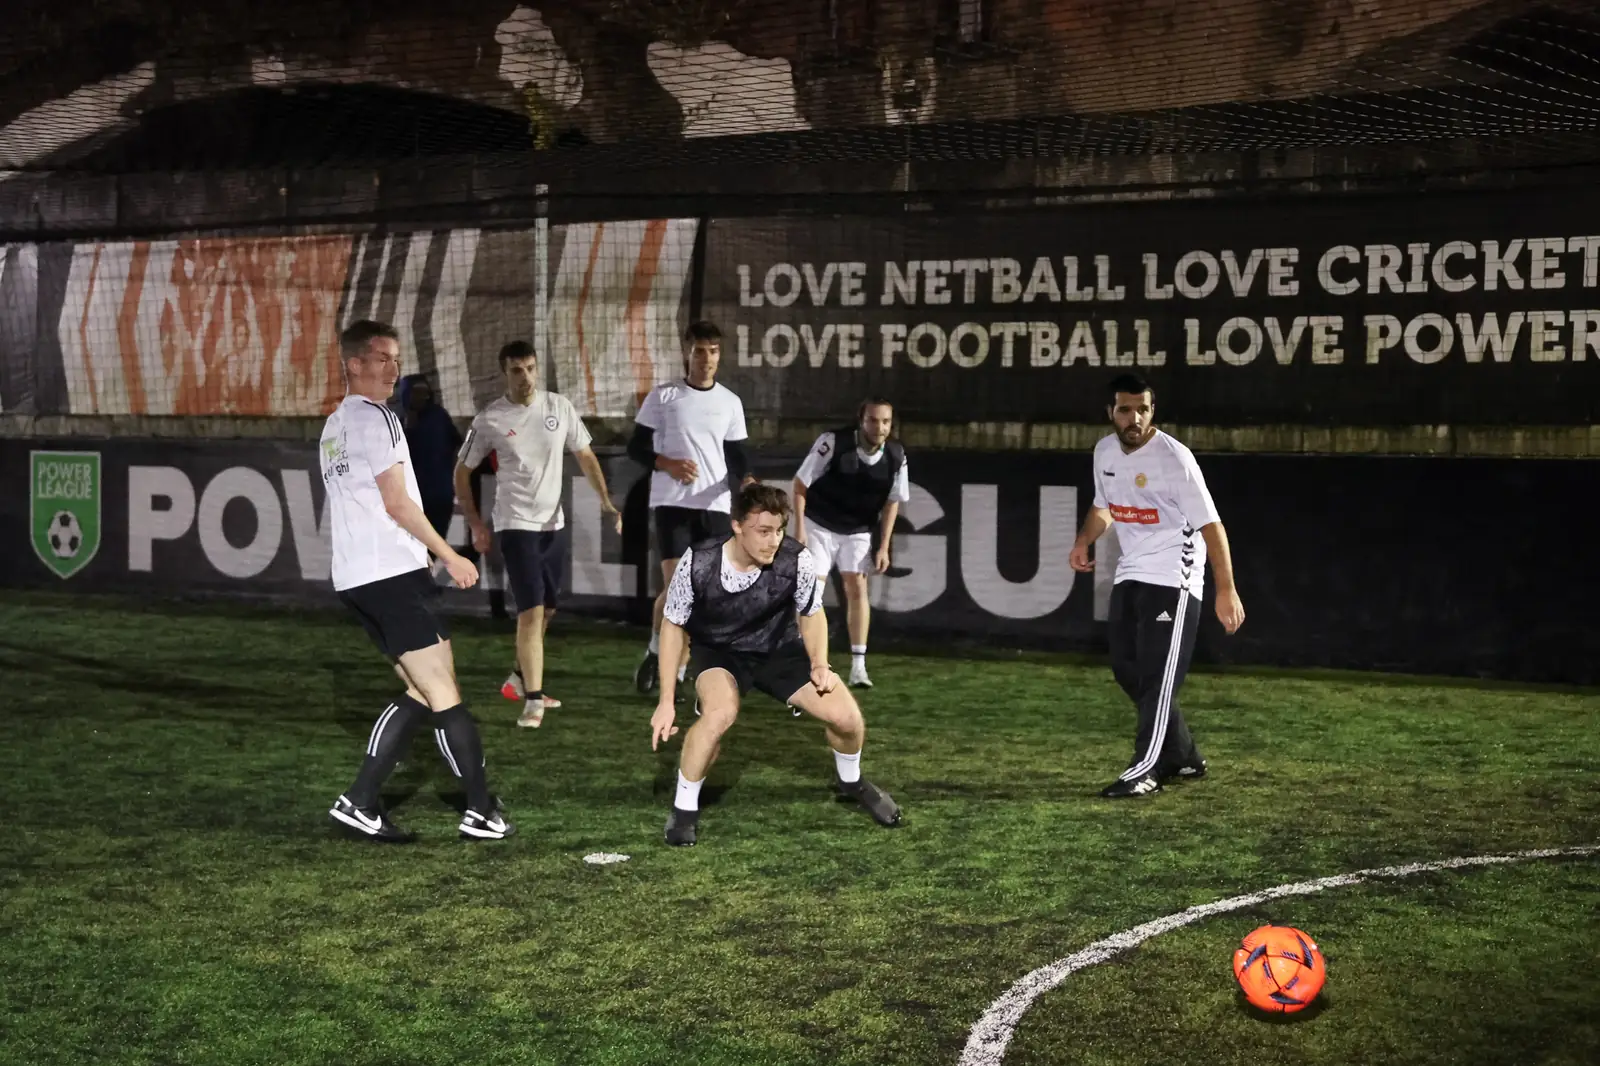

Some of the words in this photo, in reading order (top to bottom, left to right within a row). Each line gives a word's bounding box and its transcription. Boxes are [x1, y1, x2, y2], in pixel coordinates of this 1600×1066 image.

[736, 262, 867, 307] LOVE
[880, 256, 1126, 305] NETBALL
[1142, 247, 1299, 299] LOVE
[1317, 236, 1600, 295] CRICKET
[736, 323, 865, 368] LOVE
[879, 319, 1167, 368] FOOTBALL
[1184, 316, 1344, 366] LOVE
[1363, 309, 1600, 364] POWER
[38, 462, 92, 480] POWER
[38, 480, 92, 499] LEAGUE
